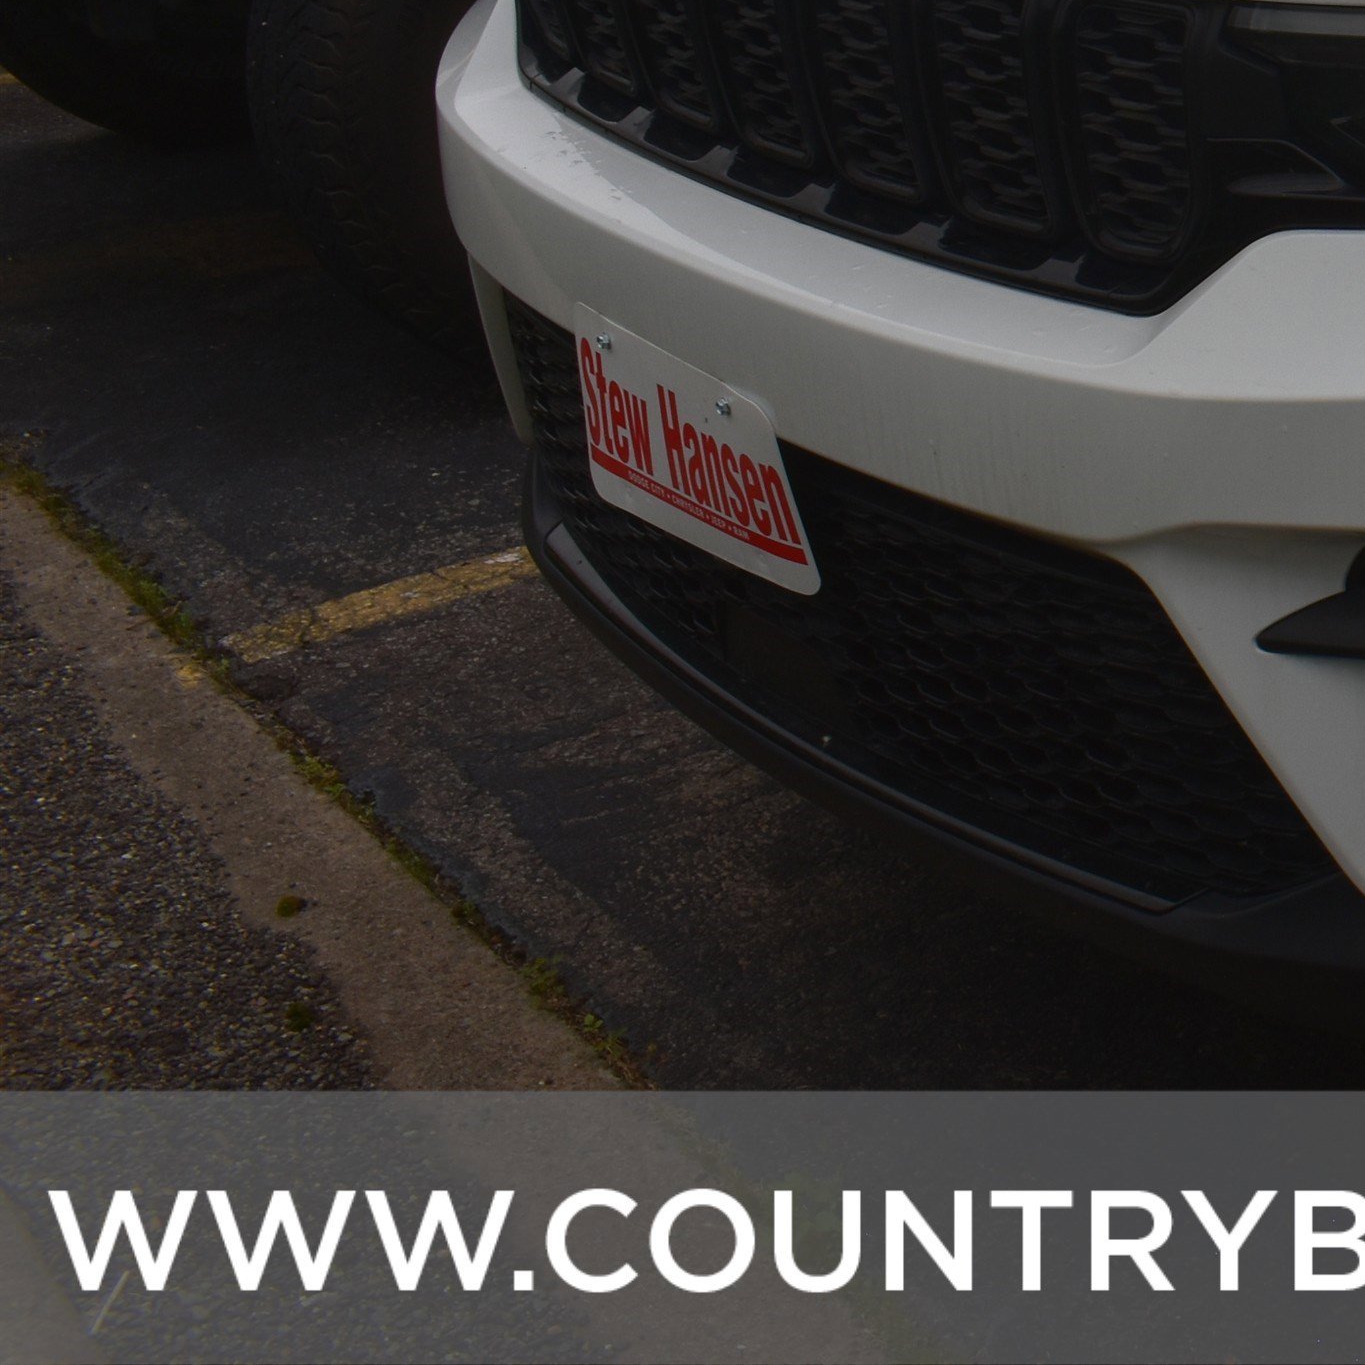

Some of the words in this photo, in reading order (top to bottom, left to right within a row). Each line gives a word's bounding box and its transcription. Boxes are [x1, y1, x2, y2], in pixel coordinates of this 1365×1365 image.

[579, 336, 654, 477] Stew
[656, 383, 802, 546] Hansen
[671, 492, 706, 520] CHRYSLER
